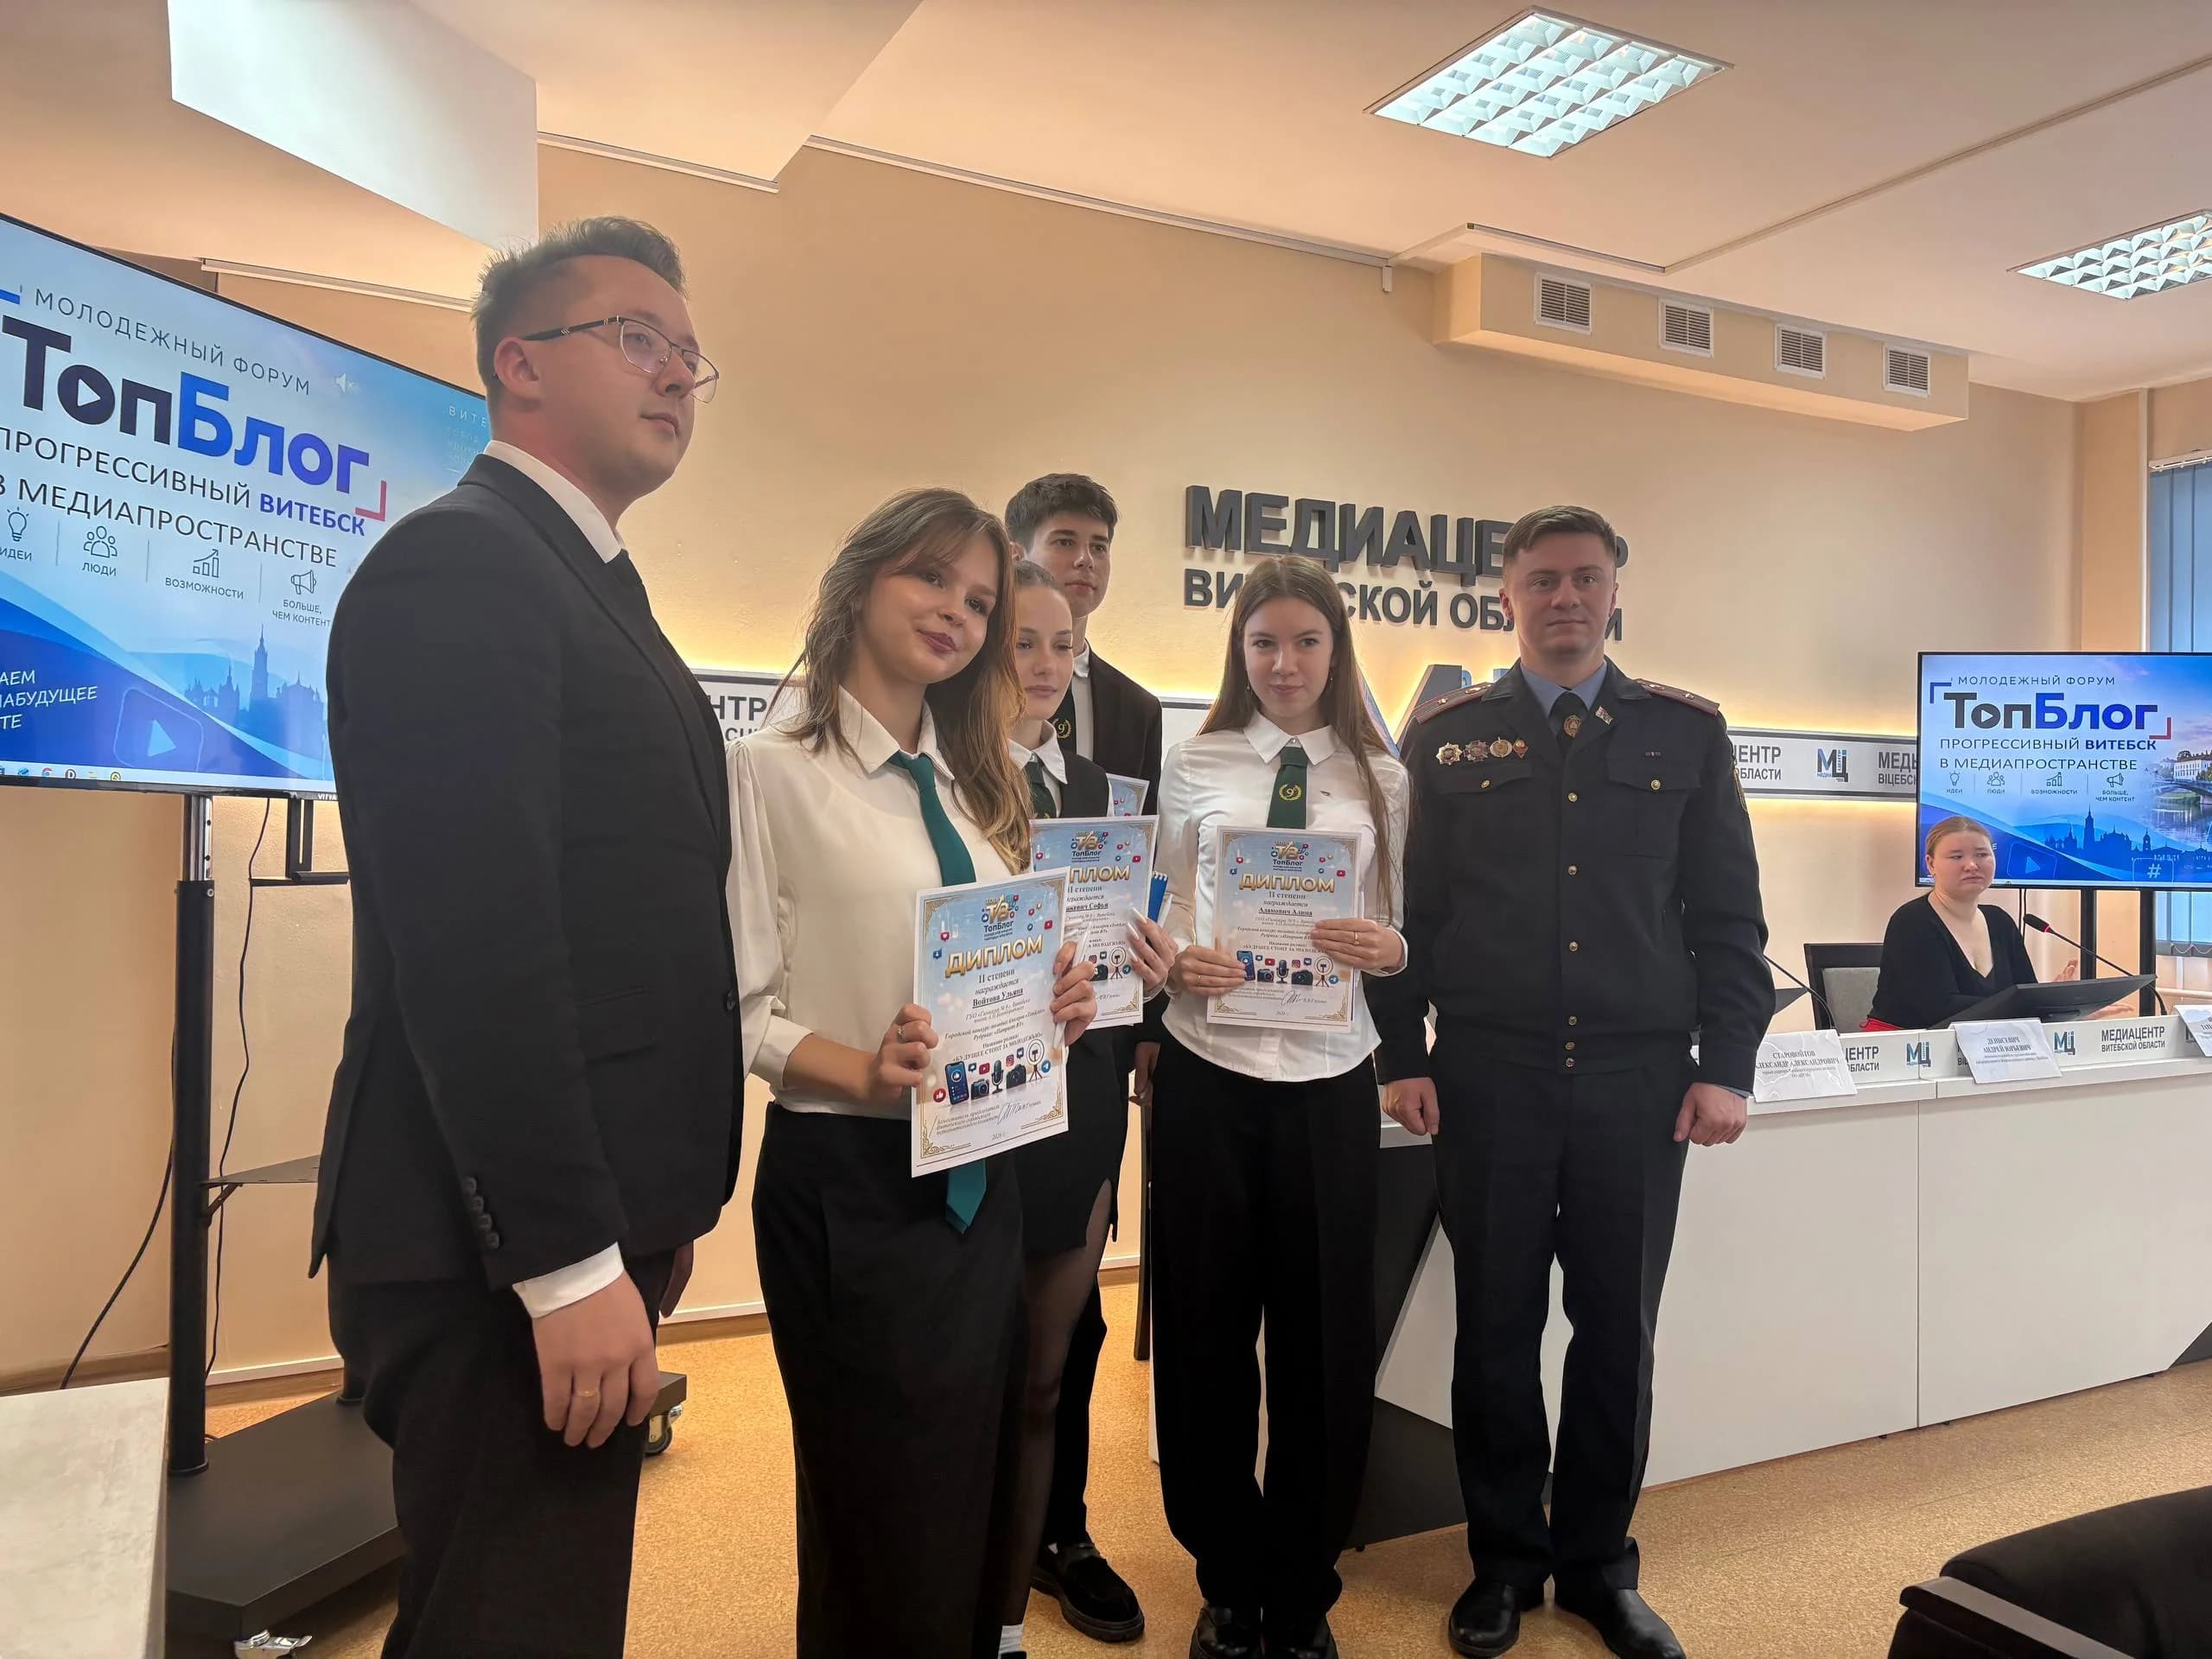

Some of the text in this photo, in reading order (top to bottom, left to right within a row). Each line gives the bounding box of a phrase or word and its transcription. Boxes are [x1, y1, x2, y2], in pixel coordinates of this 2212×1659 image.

[35, 289, 310, 396] МОЛОДЕЖНЫЙ ФОРУМ
[2, 314, 370, 494] ТопБлог
[449, 405, 486, 427] ВИТЕ
[18, 478, 337, 568] МЕДИАПРОСТРАНСТВЕ
[260, 493, 365, 537] ВИТЕБСК
[1185, 485, 1629, 587] МЕДИАЦЕ
[81, 563, 117, 576] ЛЮДИ
[165, 577, 244, 600] ВОЗМОЖНОСТИ
[1185, 569, 1438, 627] ВИСКОЙ
[272, 610, 290, 620] ЧЕМ
[283, 599, 322, 614] БОЛЬШЕ,
[1958, 675, 2115, 687] МОЛОДЕЖНЫЙ ФОРУМ
[1943, 692, 2158, 730] ТопБлог
[1940, 737, 2157, 750] ПРОГРЕССИВНЫЙ ВИТЕБСК
[1940, 759, 2138, 770] В МЕДИАПРОСТРАНСТВЕ
[1069, 864, 1131, 884] ПЛОМ
[1239, 873, 1335, 893] ДИПЛОМ
[945, 934, 1044, 978] ДИПЛОМ
[987, 969, 1015, 982] степени
[975, 978, 1020, 995] награждается
[1001, 988, 1024, 999] Ульяна
[2101, 1027, 2165, 1042] МЕДИАЦЕНТР
[2101, 1040, 2165, 1052] ВИТЕБСКОЙ ОБЛАСТИ
